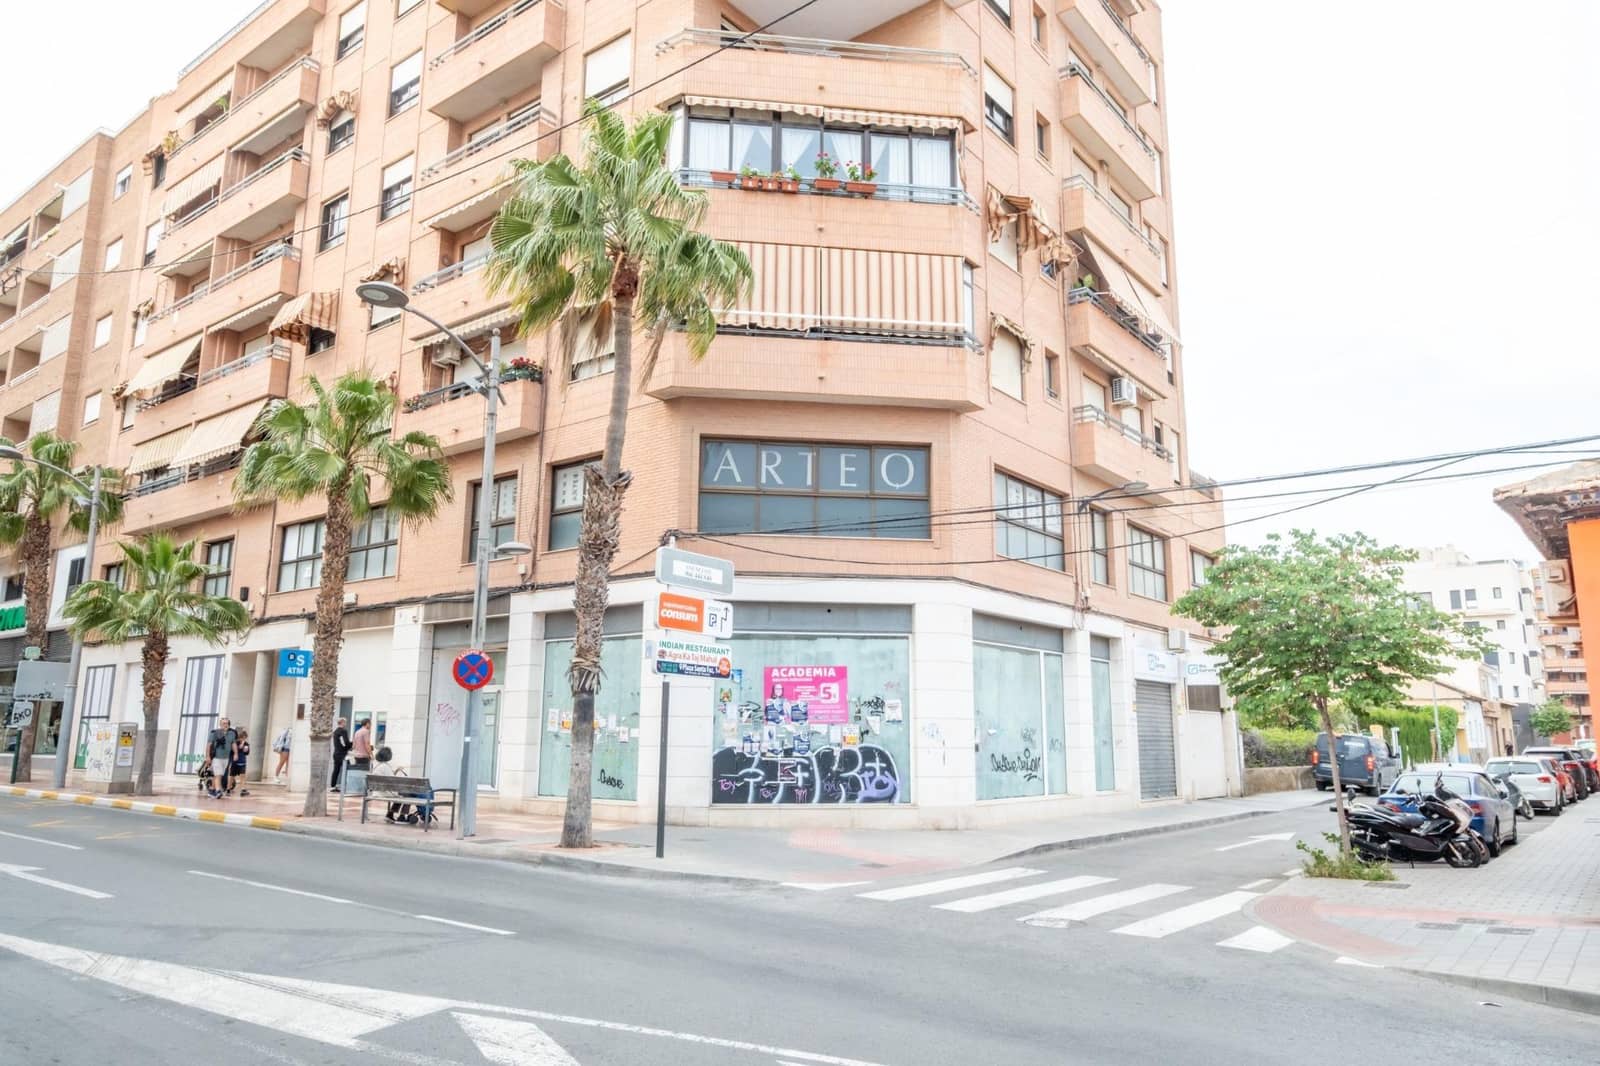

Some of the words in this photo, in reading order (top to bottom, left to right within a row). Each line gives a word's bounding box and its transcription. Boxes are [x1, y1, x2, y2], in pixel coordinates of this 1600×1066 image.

[708, 612, 718, 627] P
[659, 640, 684, 650] INDIAN
[685, 644, 730, 655] RESTAURANT
[286, 666, 305, 675] ATM
[771, 667, 836, 678] ACADEMIA
